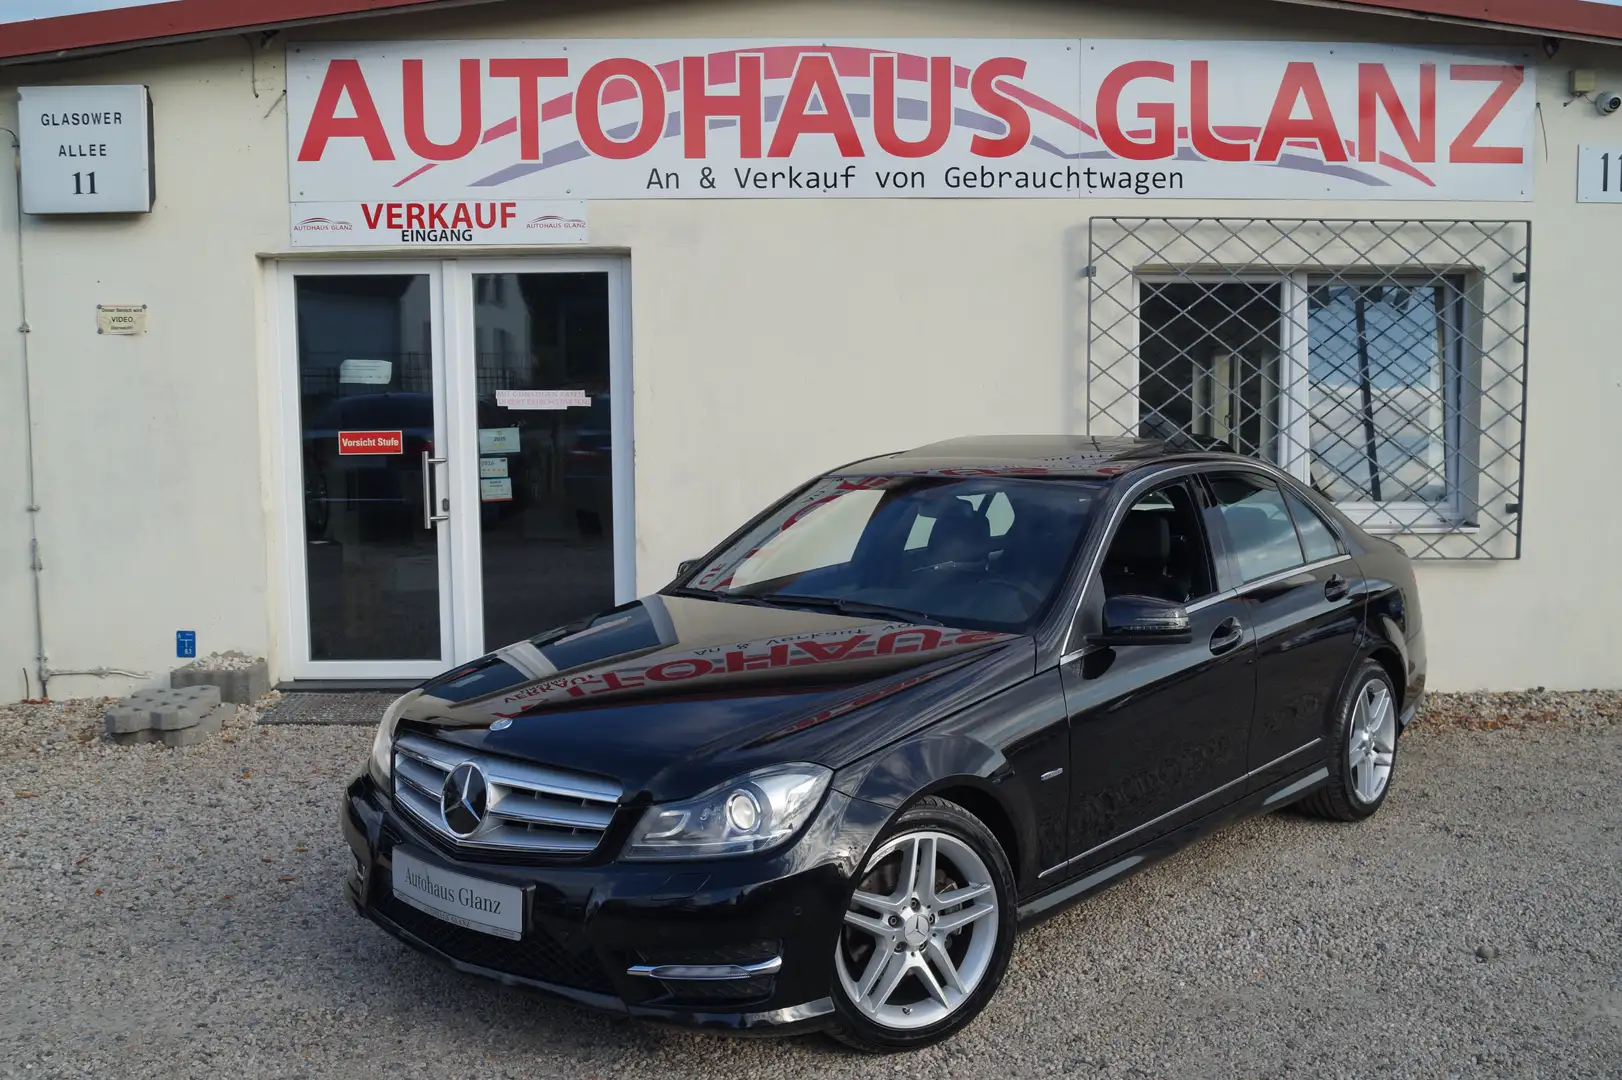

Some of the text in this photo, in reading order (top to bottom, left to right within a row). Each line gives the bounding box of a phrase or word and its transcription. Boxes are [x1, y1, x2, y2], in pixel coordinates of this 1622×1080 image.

[40, 112, 123, 126] GLASOWER
[297, 57, 1524, 164] AUTOHAUS GLANZ
[58, 144, 107, 157] ALLEE
[71, 171, 98, 195] 11
[646, 166, 1184, 195] An & Verkauf von Gebrauchtwagen
[361, 202, 517, 230] VERKAUF
[564, 221, 586, 229] GLANZ
[401, 229, 473, 242] EINGANG
[342, 437, 399, 447] Vorsicht Stufe
[404, 867, 501, 915] Autohaus Glanz
